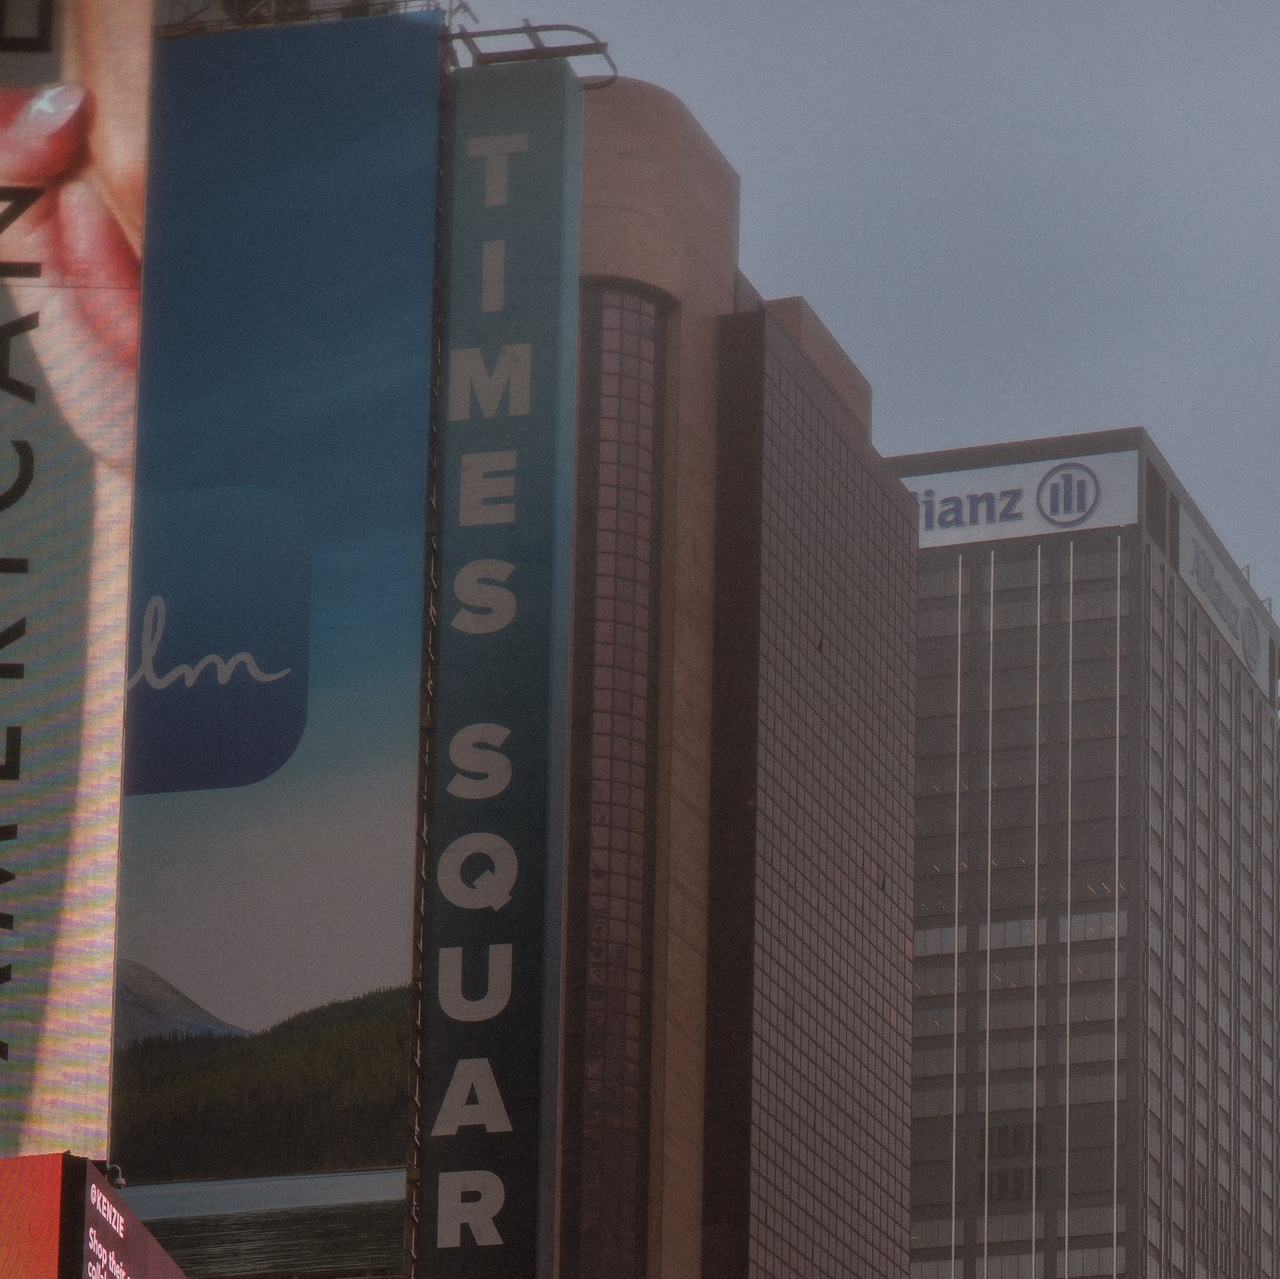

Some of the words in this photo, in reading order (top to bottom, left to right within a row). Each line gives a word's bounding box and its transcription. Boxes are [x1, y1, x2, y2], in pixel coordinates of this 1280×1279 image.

[448, 135, 532, 634] TIMES
[91, 1184, 124, 1238] @KENZIE
[89, 1227, 107, 1266] Shop
